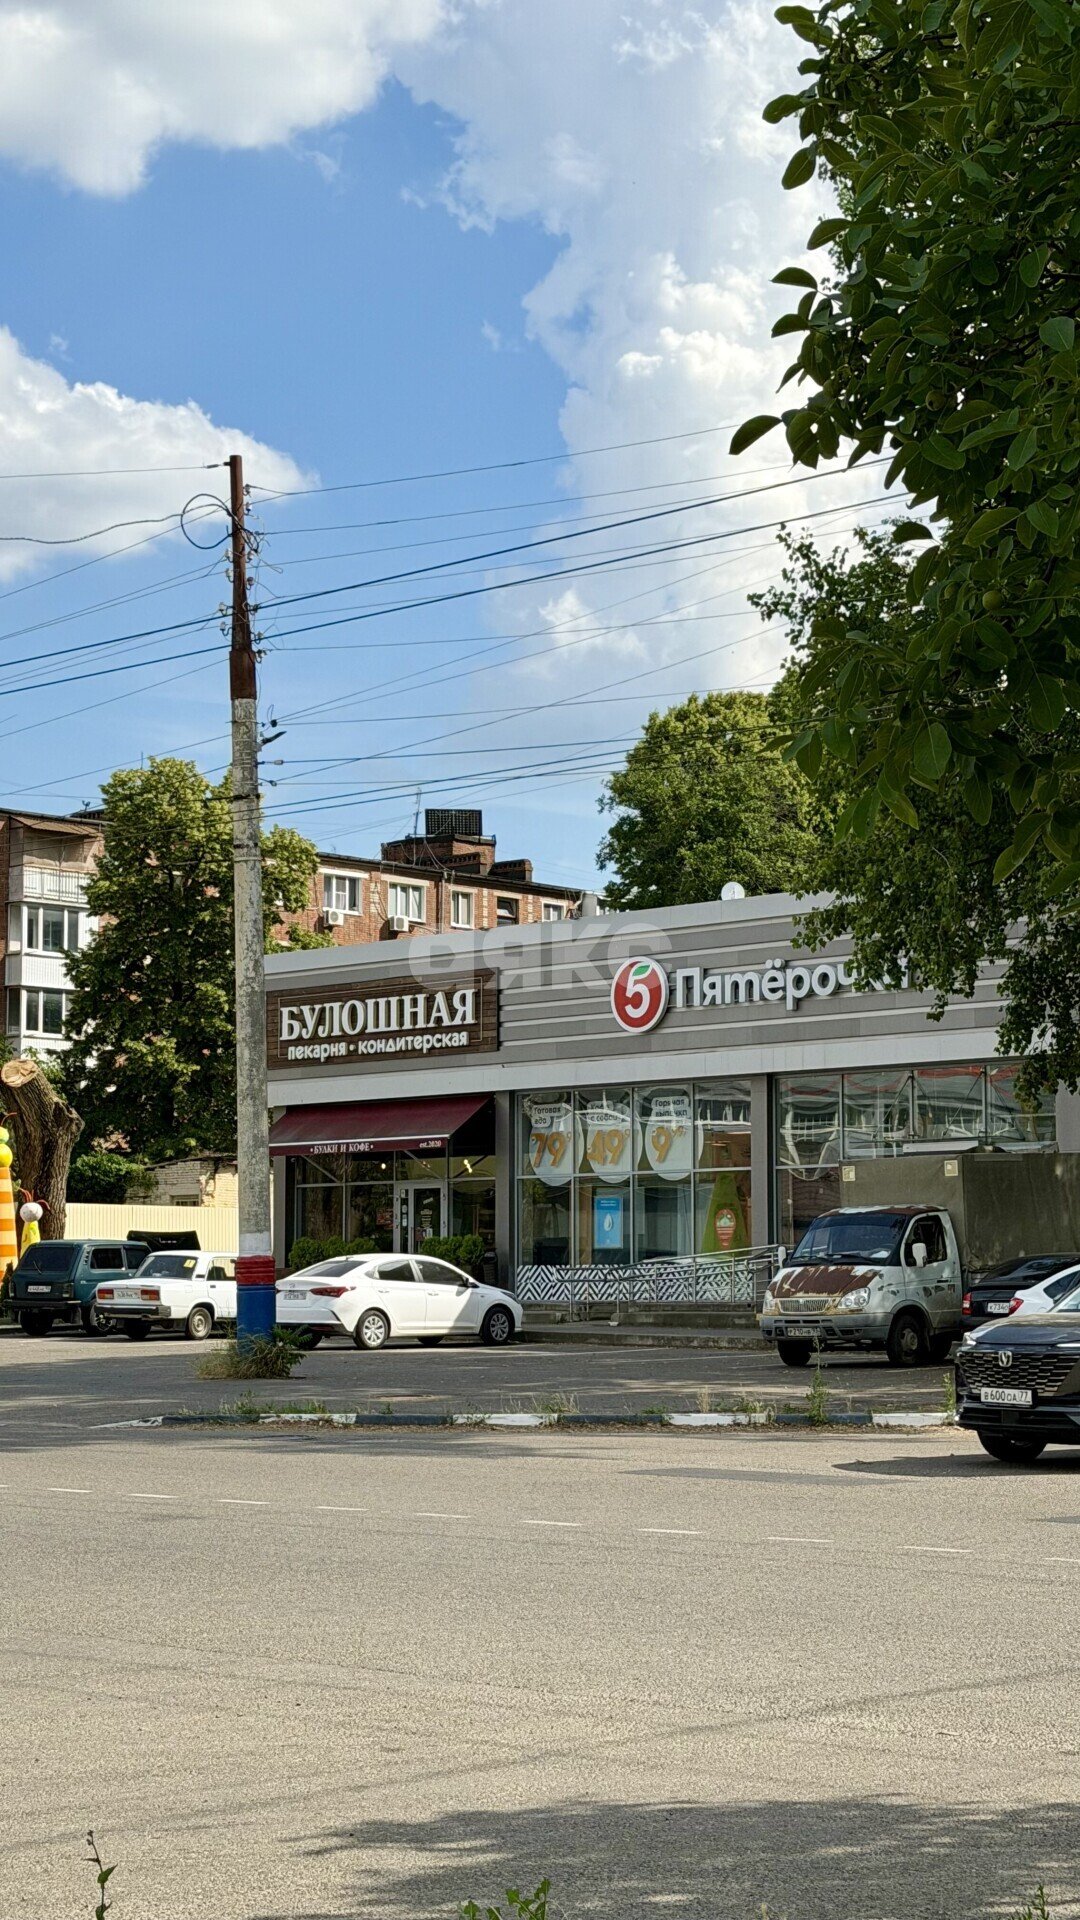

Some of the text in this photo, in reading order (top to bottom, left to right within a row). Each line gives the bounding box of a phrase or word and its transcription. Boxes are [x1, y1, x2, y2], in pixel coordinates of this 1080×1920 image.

[279, 988, 478, 1041] БУЛОШНАЯ
[287, 1030, 469, 1062] пекарня кондитерская
[313, 1142, 370, 1155] БУЛКИ И КОФЕ
